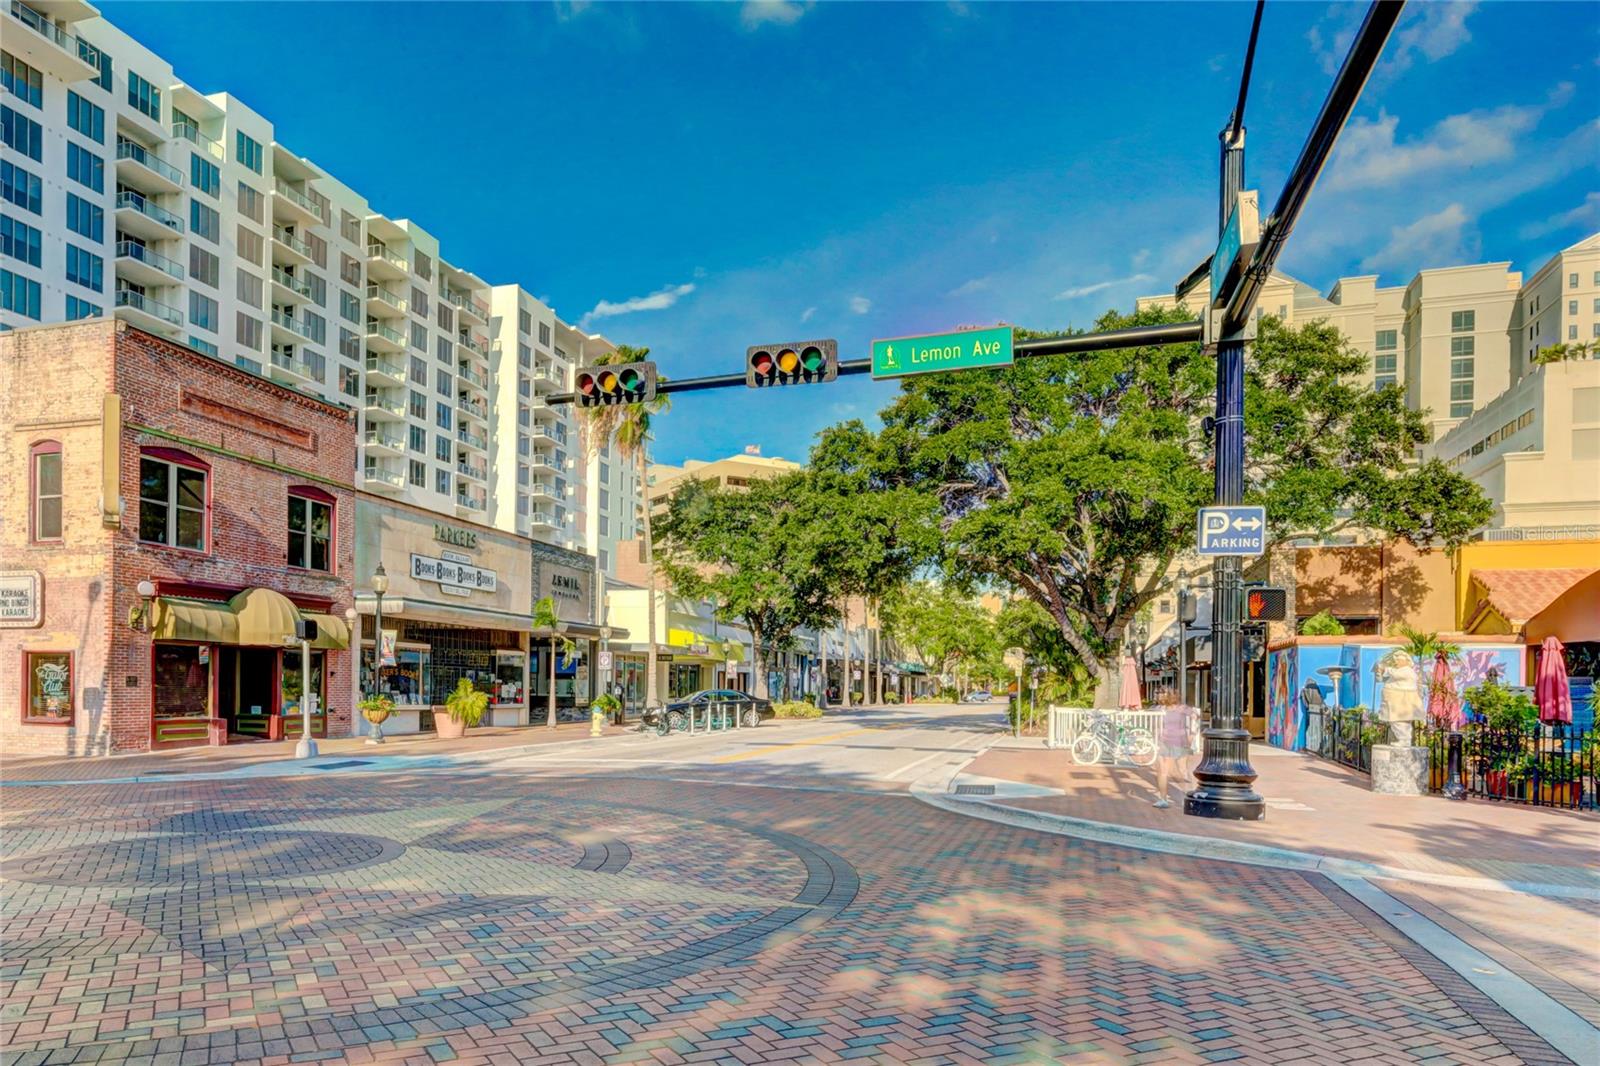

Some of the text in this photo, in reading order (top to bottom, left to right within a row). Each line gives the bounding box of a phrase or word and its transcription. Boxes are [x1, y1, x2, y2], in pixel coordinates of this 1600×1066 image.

[912, 341, 1000, 362] Lemon Ave
[1202, 512, 1260, 549] PARKING
[476, 571, 494, 587] BOOKS
